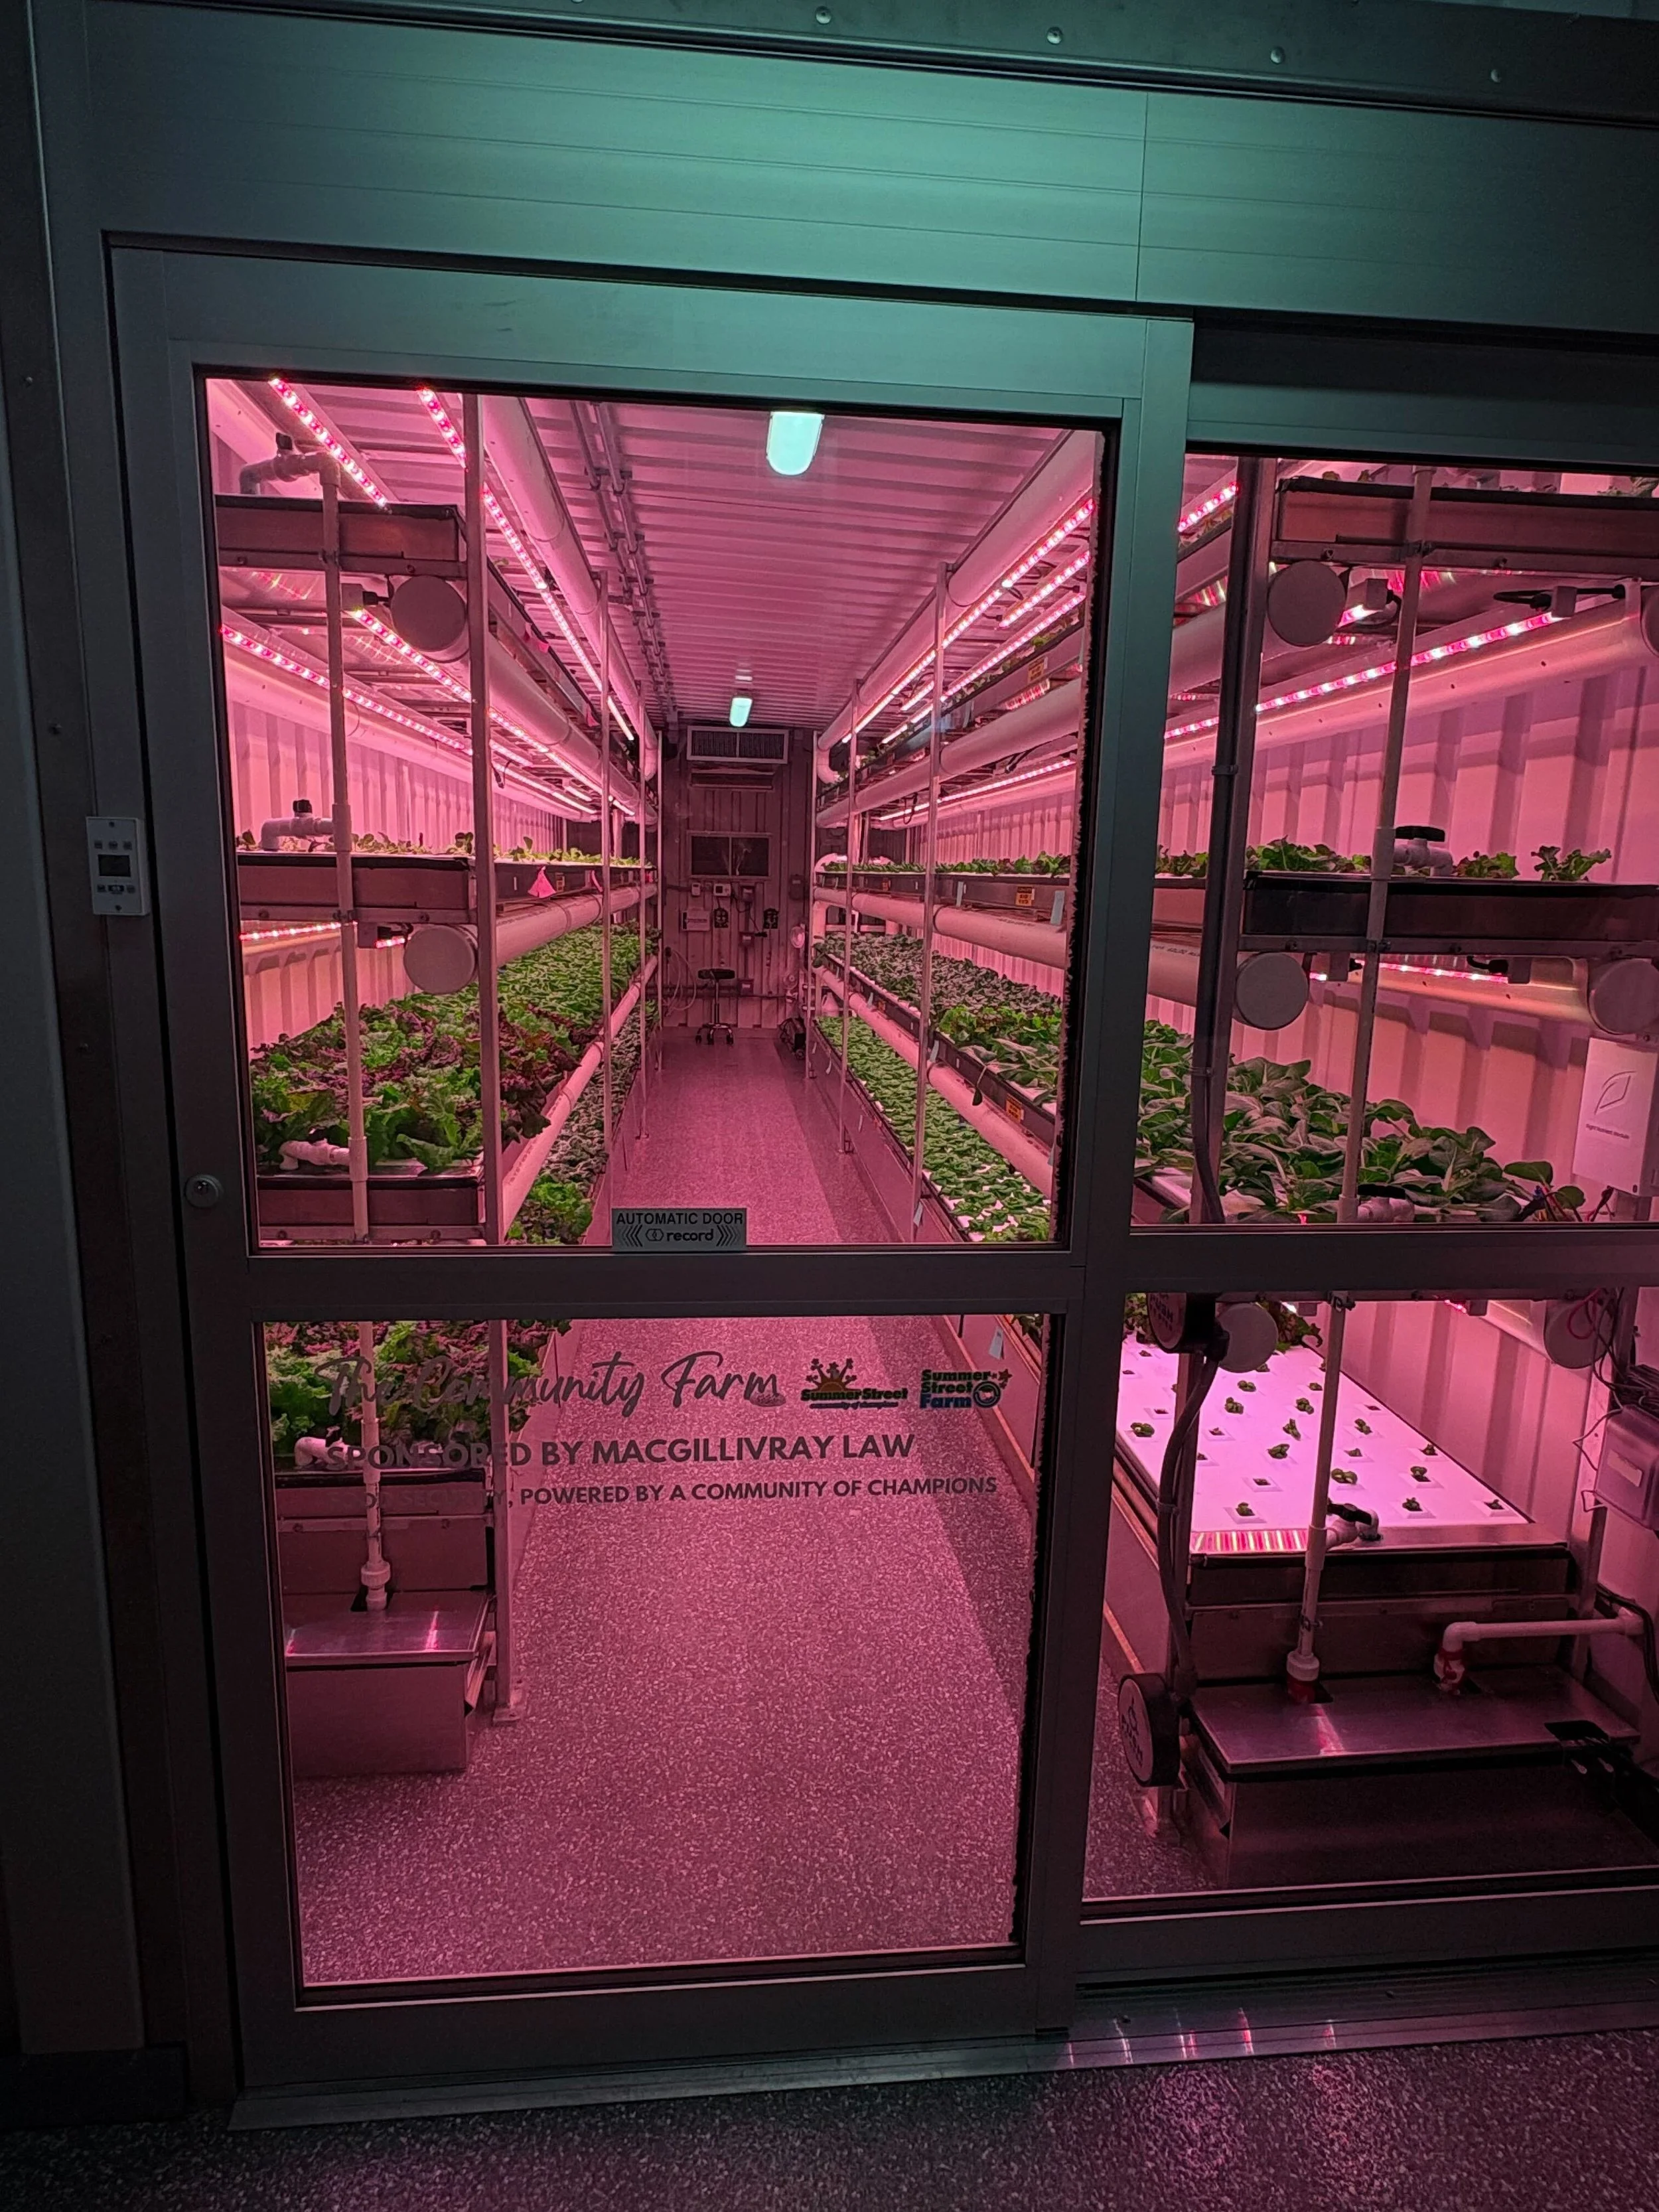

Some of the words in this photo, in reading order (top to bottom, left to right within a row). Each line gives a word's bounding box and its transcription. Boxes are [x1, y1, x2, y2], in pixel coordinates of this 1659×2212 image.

[616, 1212, 698, 1224] AUTOMATIC
[702, 1212, 743, 1224] DOOR
[666, 1228, 714, 1242] record
[921, 1368, 991, 1381] Summer
[314, 1355, 399, 1416] The
[661, 1351, 779, 1408] Farm
[921, 1381, 974, 1393] Street
[920, 1394, 972, 1408] Farm
[326, 1441, 532, 1470] SPONSORED
[542, 1441, 585, 1465] BY
[593, 1435, 833, 1465] MACGILLIVRAY
[843, 1434, 915, 1459] LAW
[521, 1486, 629, 1506] POWERED
[636, 1485, 664, 1502] BY
[670, 1484, 686, 1501] A
[691, 1481, 828, 1501] COMMUNITY
[833, 1480, 863, 1498] OF
[867, 1477, 997, 1496] CHAMPIONS
